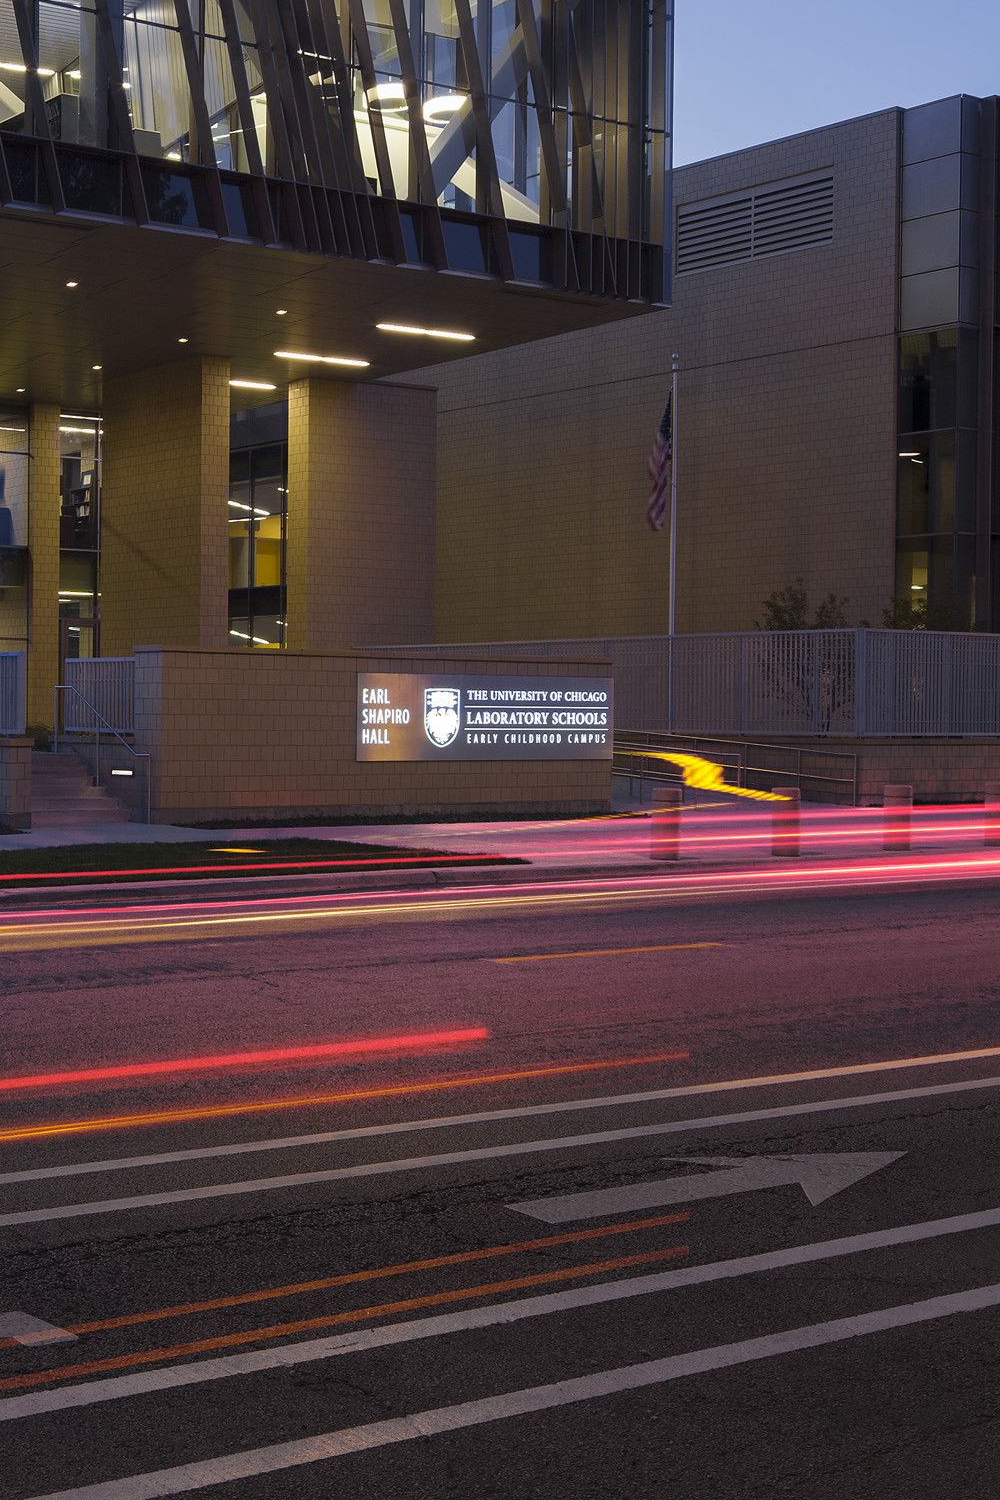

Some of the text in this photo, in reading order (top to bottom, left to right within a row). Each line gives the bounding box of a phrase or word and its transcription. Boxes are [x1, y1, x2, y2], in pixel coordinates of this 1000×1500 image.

[362, 688, 390, 704] EARL
[467, 690, 607, 702] THE UNIVERSITY OF CHICAGO
[362, 708, 410, 724] SHAPIRO
[466, 711, 607, 725] LABORATORY SCHOOLS
[362, 728, 390, 744] HALL
[466, 733, 606, 744] EARLY CHILDHOOD CAMPUS
